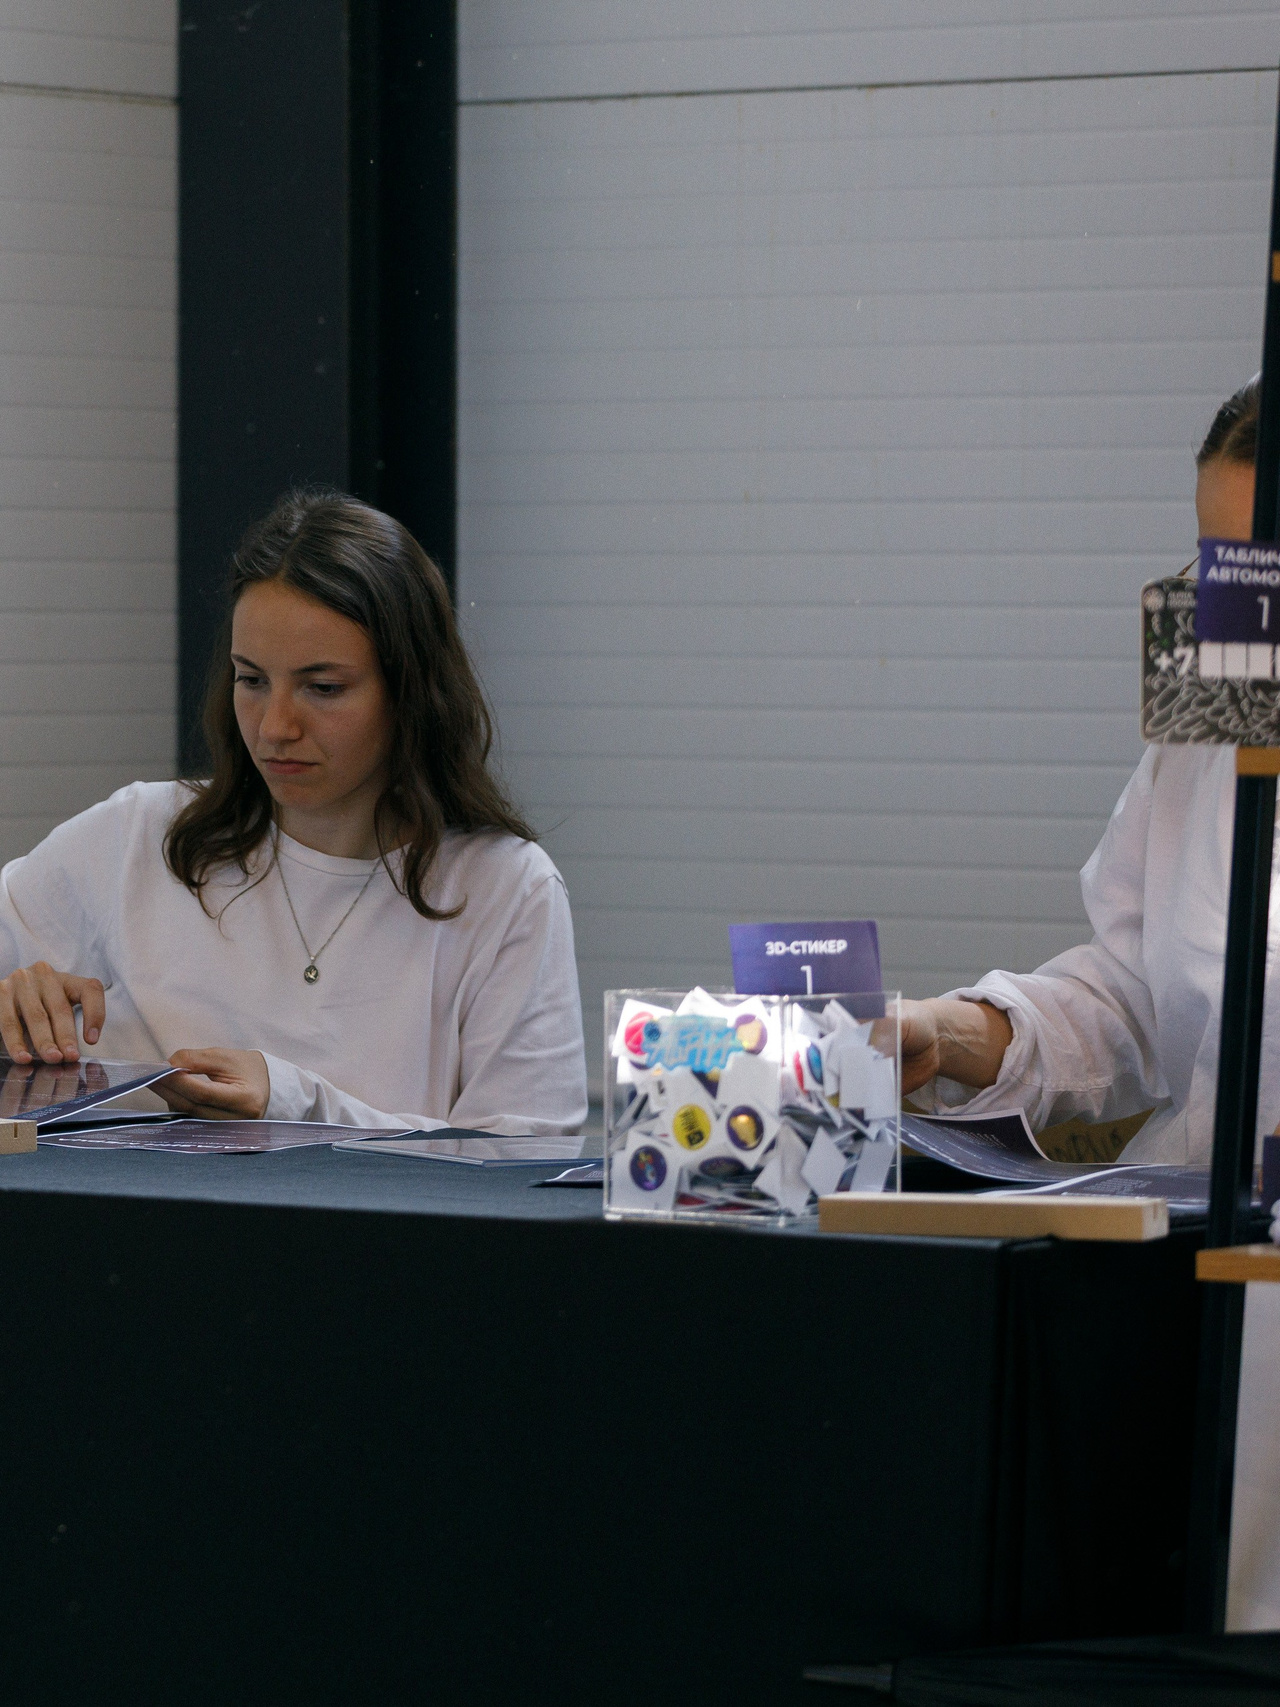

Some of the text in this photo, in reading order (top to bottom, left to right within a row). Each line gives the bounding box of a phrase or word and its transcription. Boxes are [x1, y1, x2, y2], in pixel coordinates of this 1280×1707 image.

[1257, 595, 1270, 630] 1
[765, 939, 848, 956] 3D-СТИКЕР
[800, 965, 813, 995] 1
